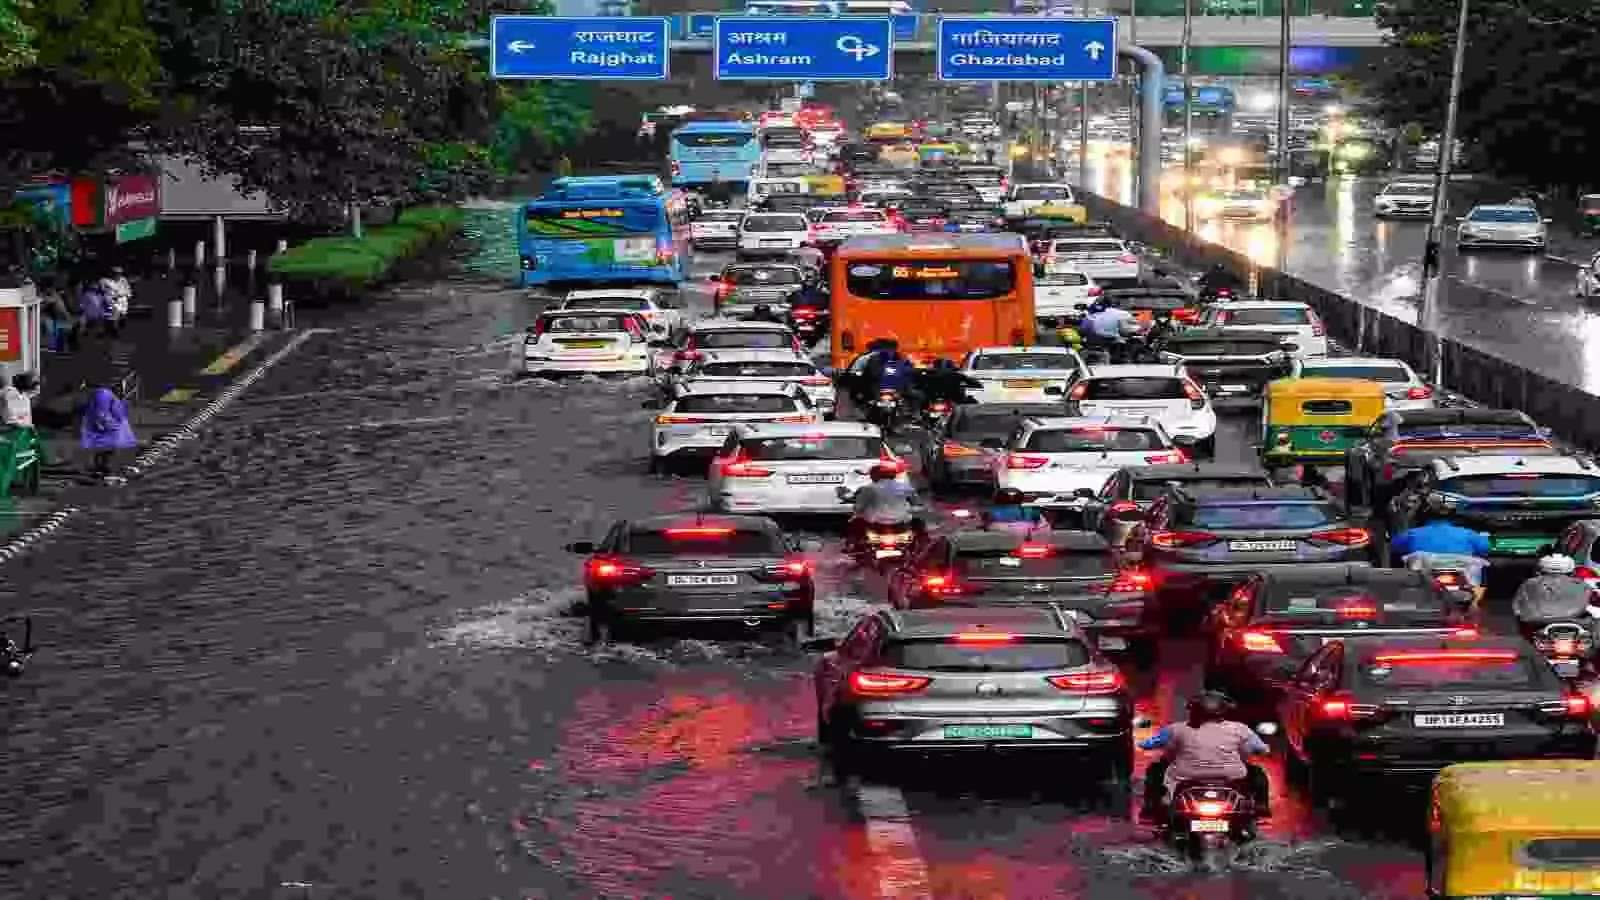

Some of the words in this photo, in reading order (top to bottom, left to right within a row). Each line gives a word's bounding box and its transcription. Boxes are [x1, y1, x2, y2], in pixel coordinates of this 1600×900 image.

[575, 31, 656, 43] राजघाट
[727, 31, 787, 46] आश्रम
[570, 51, 657, 67] Rajghat
[727, 52, 812, 65] Ashram
[949, 53, 1065, 66] Ghaziabad
